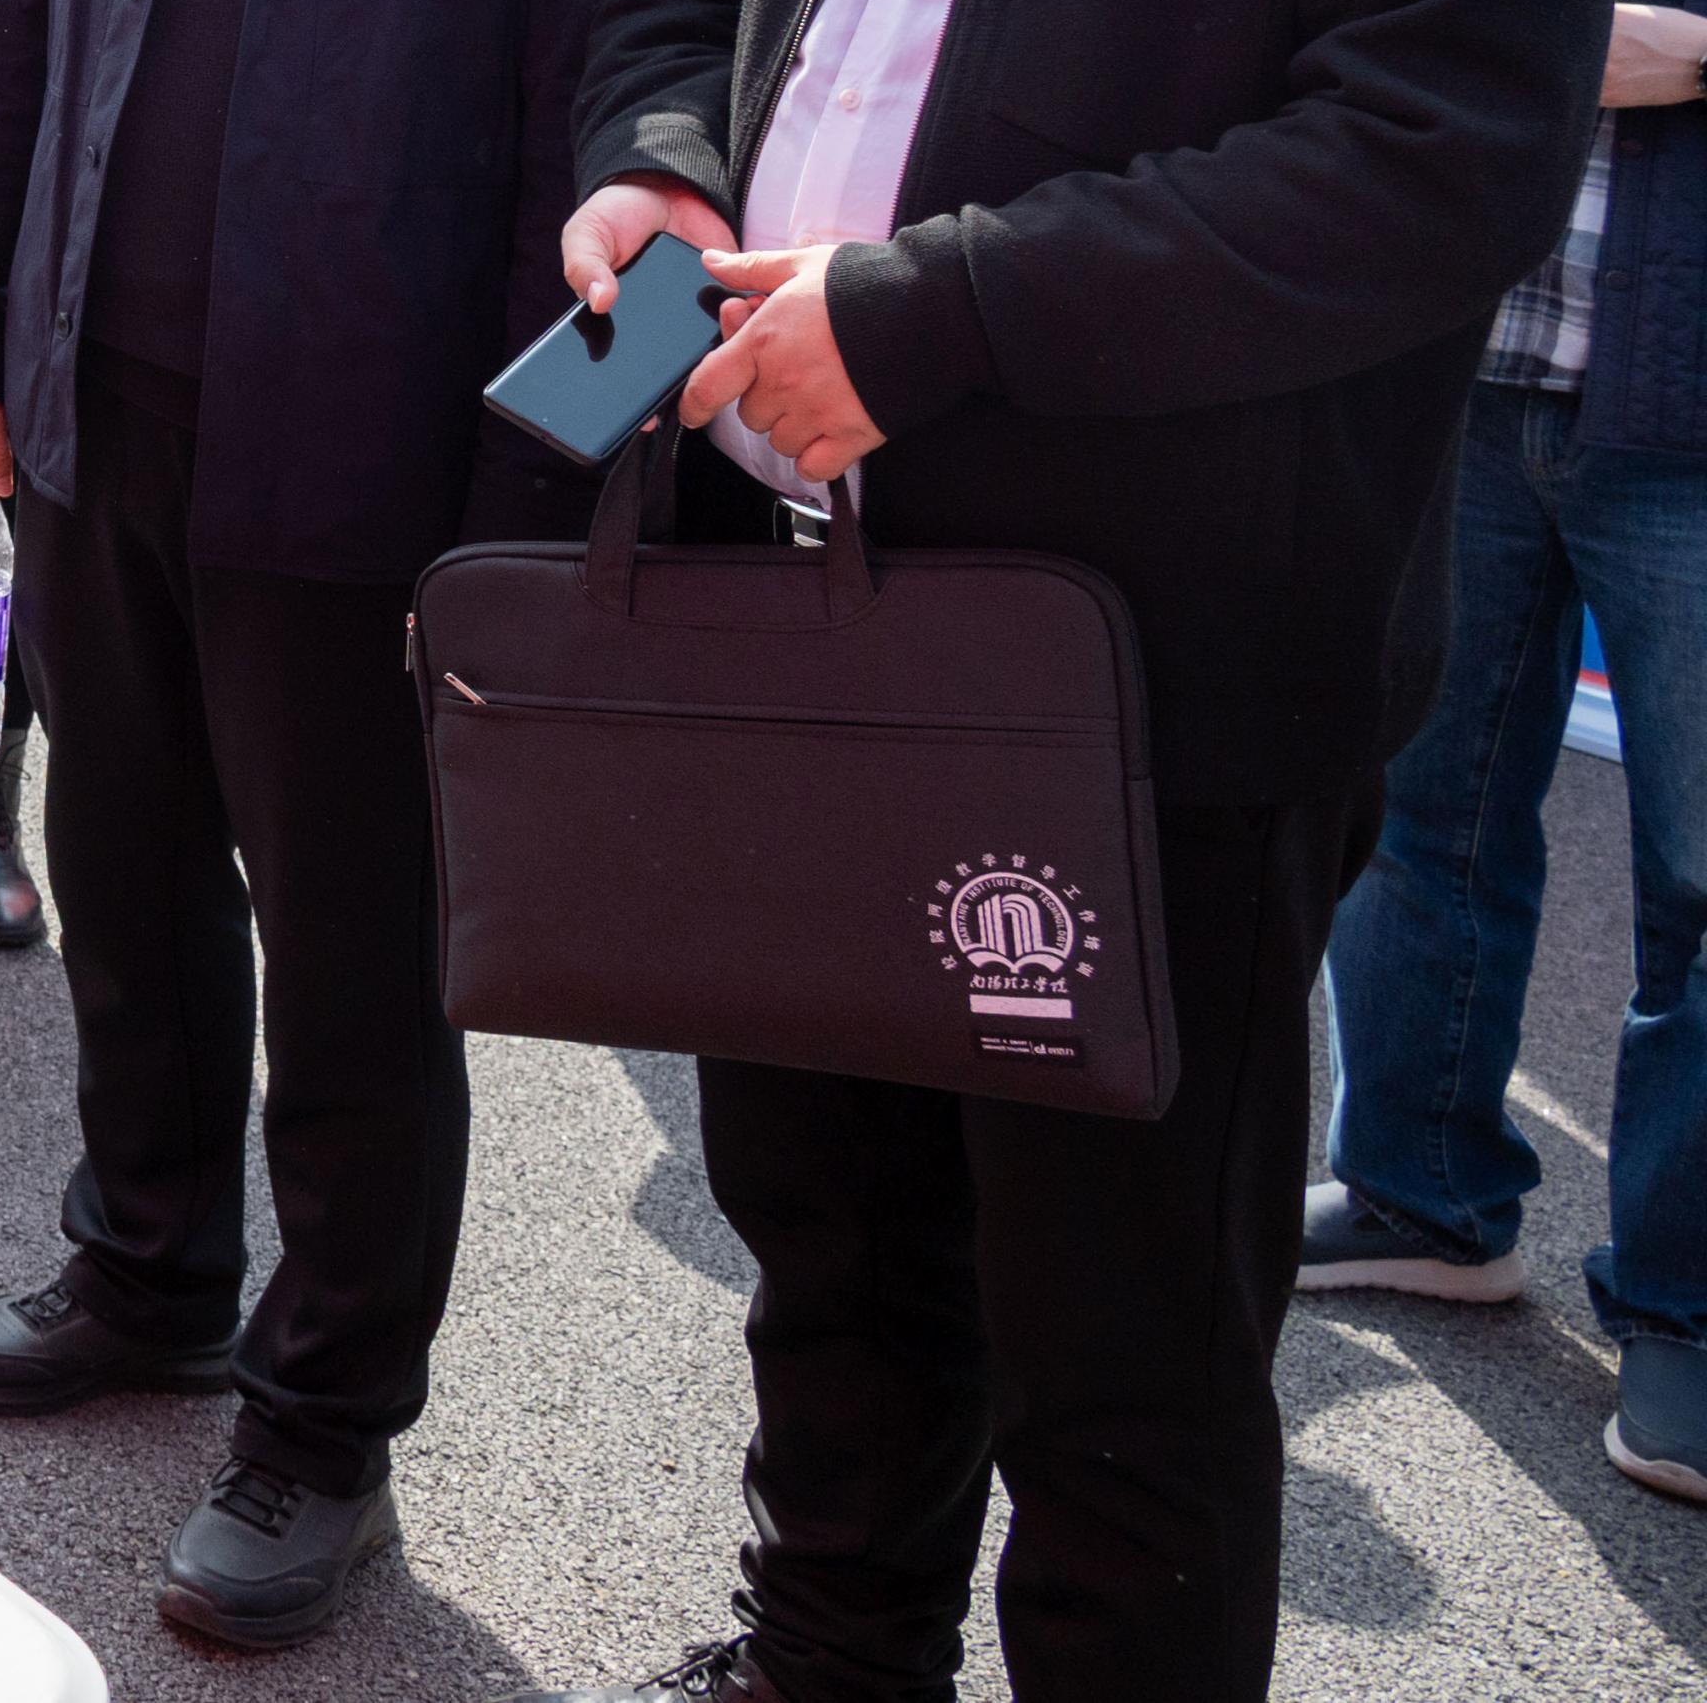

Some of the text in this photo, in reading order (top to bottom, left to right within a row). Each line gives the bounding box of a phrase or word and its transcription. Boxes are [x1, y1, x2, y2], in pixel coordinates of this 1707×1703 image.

[964, 878, 1017, 902] INSTITUTE
[1020, 880, 1036, 893] OF
[1038, 891, 1068, 949] TECHNOLOGY
